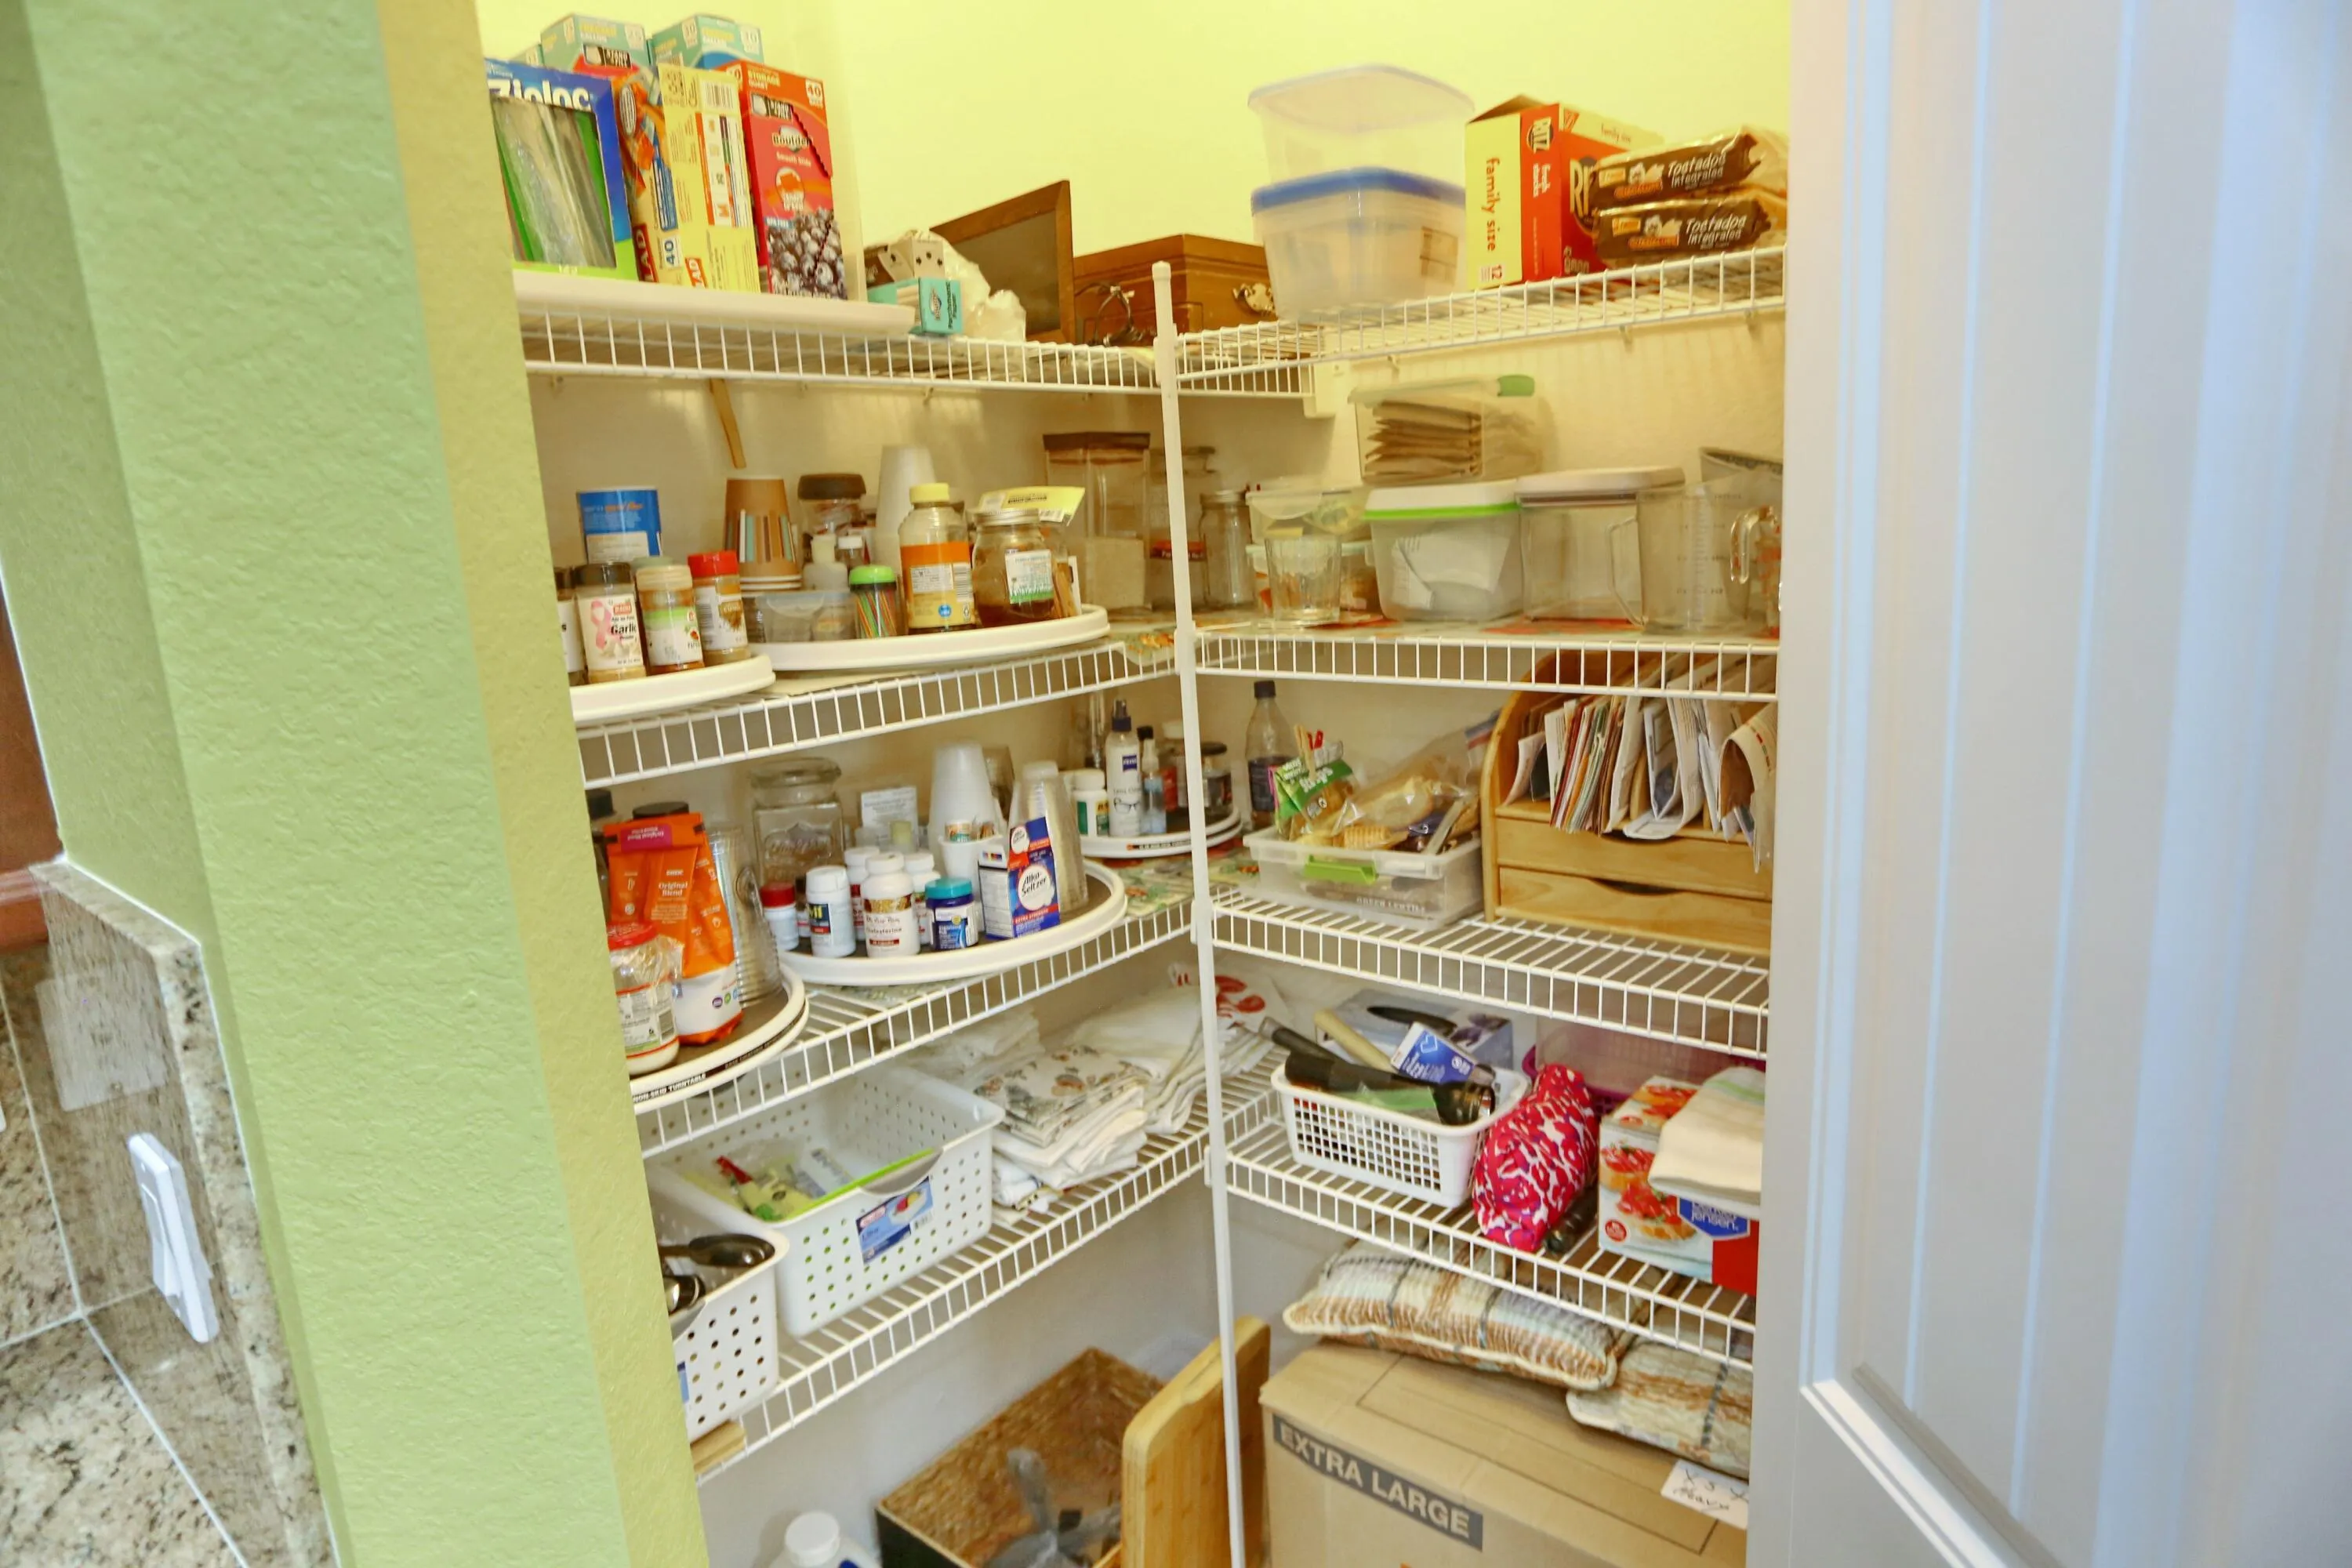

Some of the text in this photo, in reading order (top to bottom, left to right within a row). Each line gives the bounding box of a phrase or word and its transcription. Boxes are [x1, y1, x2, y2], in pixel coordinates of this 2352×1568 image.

[808, 84, 822, 99] 40
[1533, 117, 1552, 154] RITZ
[1668, 152, 1726, 178] Tostados
[1481, 158, 1501, 252] family size
[1686, 212, 1748, 234] Tostados
[663, 239, 676, 267] 40
[1490, 264, 1503, 281] 12
[658, 881, 688, 890] Original
[1022, 876, 1047, 896] Seltzer
[668, 1073, 706, 1093] TURNTABLE
[1279, 1421, 1471, 1539] EXTRA LARGE
